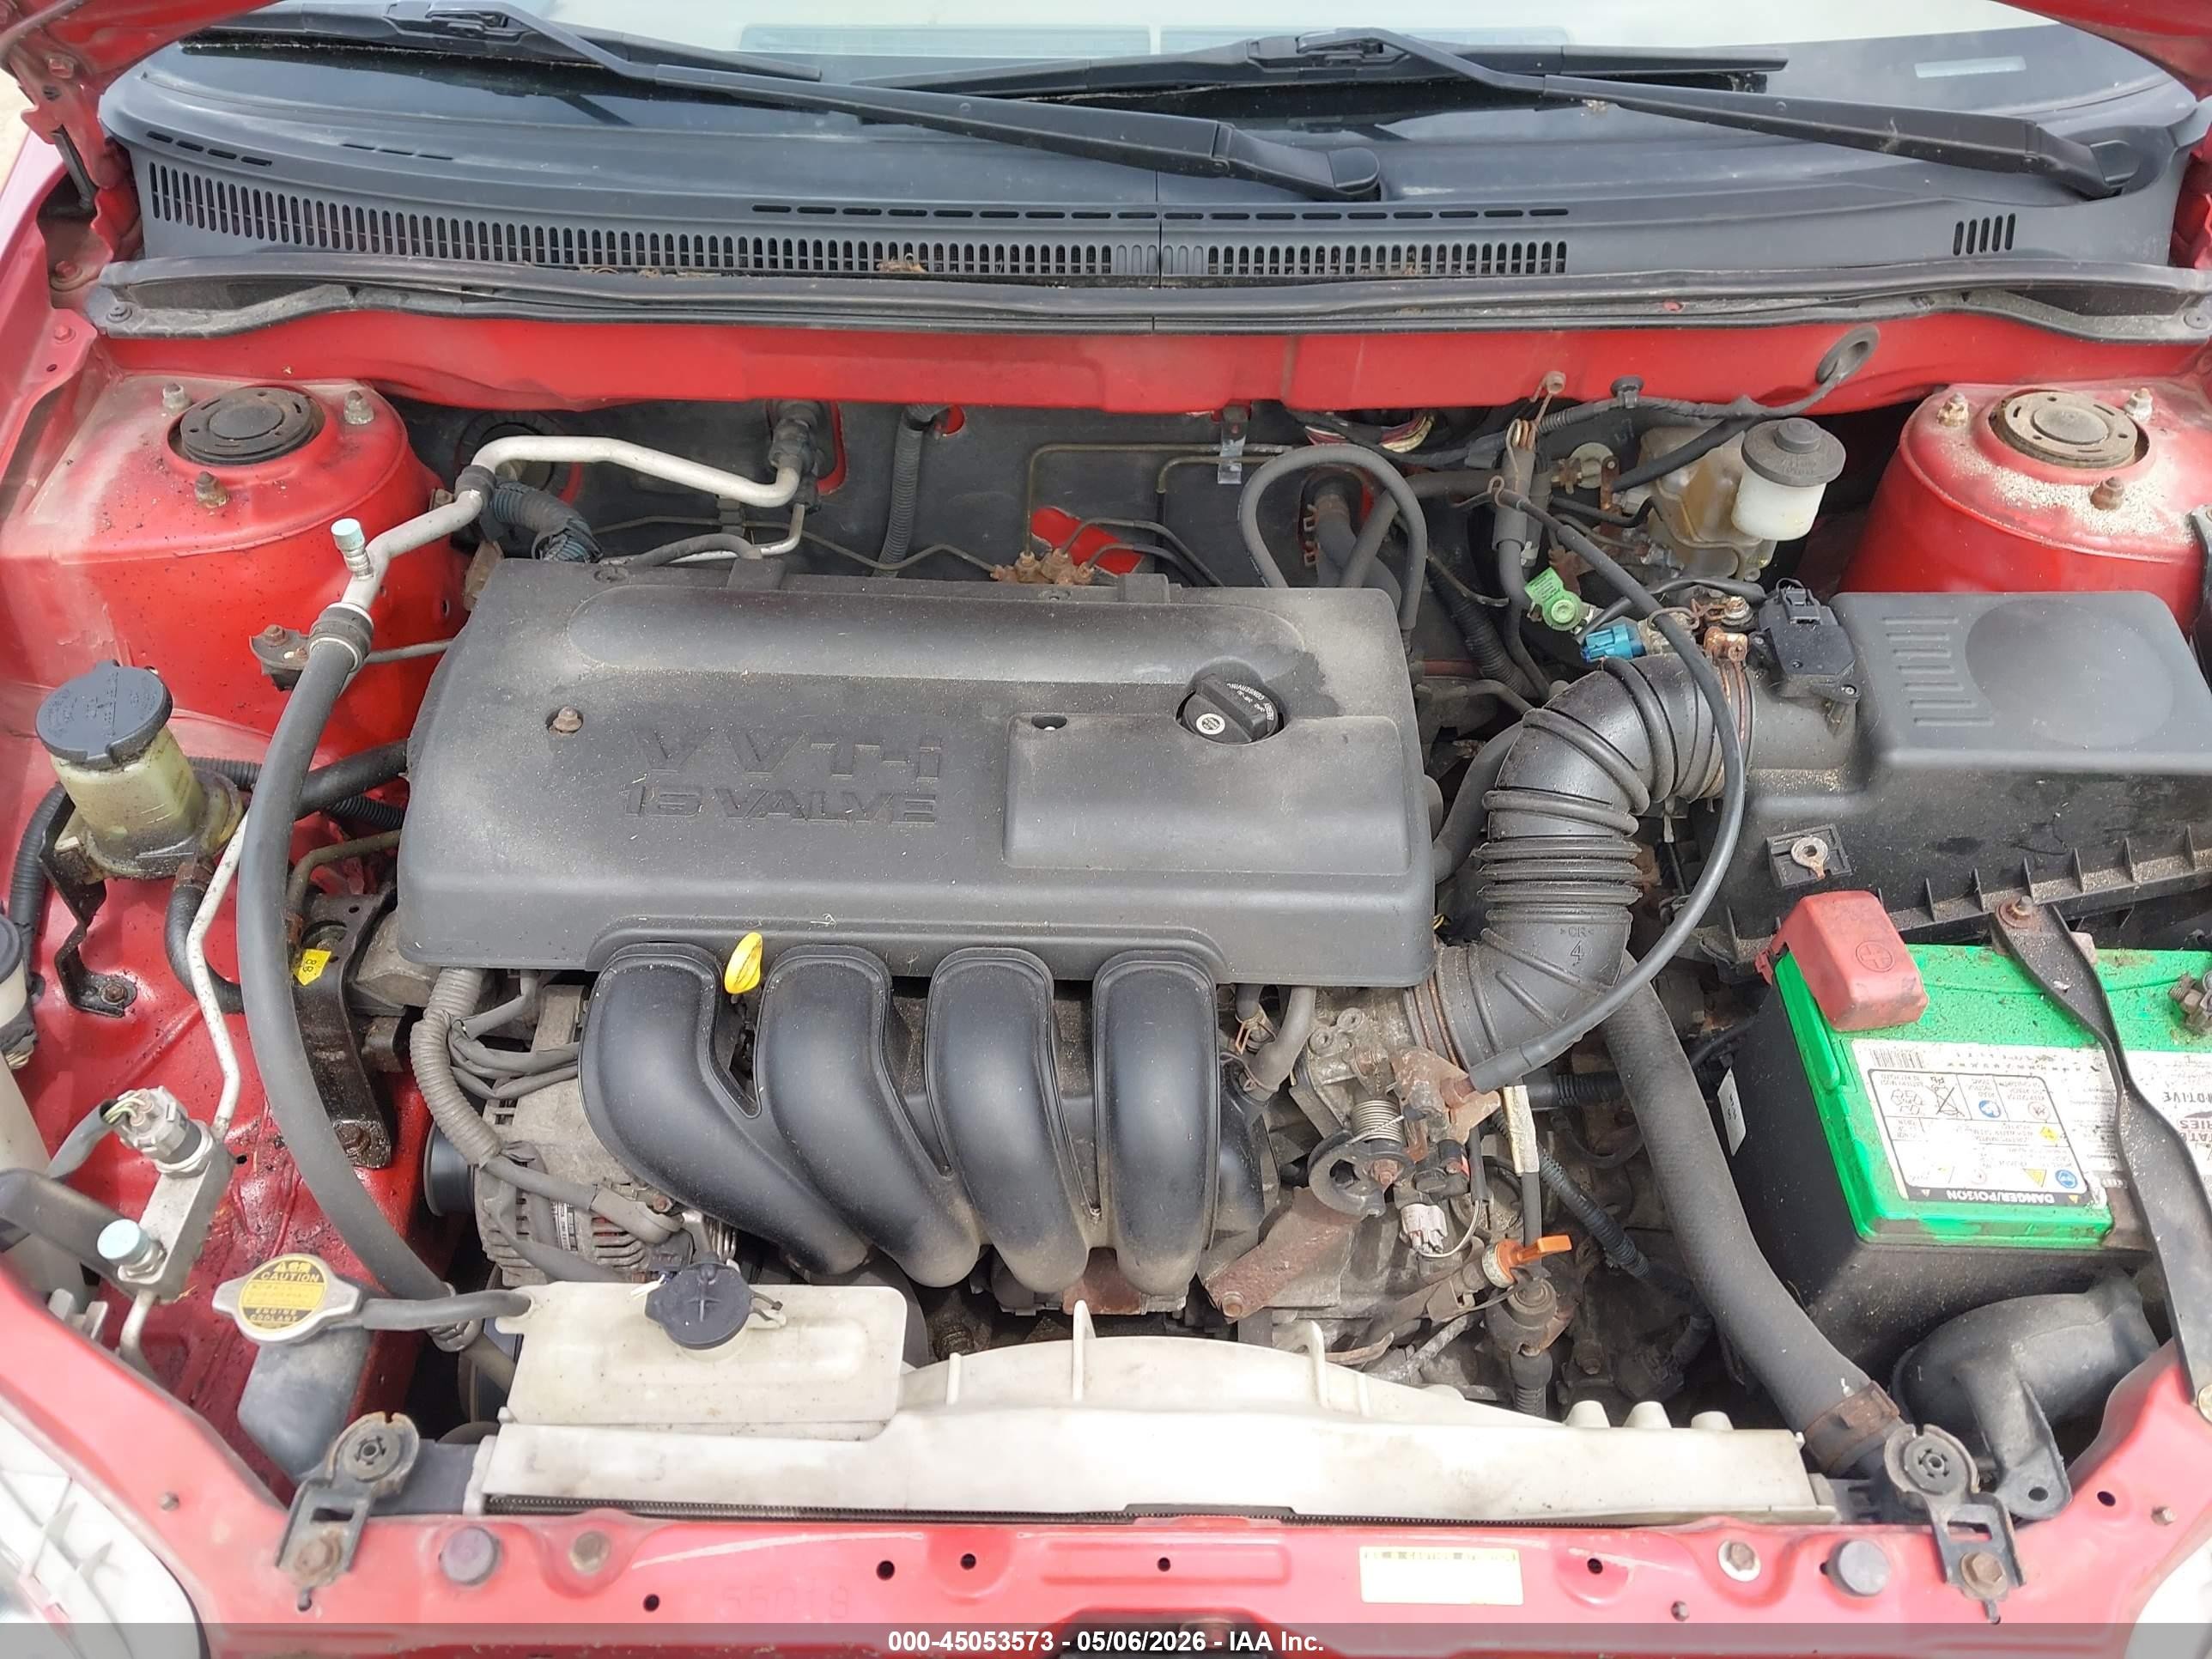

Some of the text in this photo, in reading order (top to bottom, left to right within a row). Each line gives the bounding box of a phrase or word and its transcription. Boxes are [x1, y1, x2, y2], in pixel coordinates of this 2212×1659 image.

[622, 785, 938, 824] 16 VALVE
[1570, 939, 1585, 962] 4
[1946, 1188, 2055, 1204] DANGER/POISON
[260, 1271, 319, 1282] CAUTION
